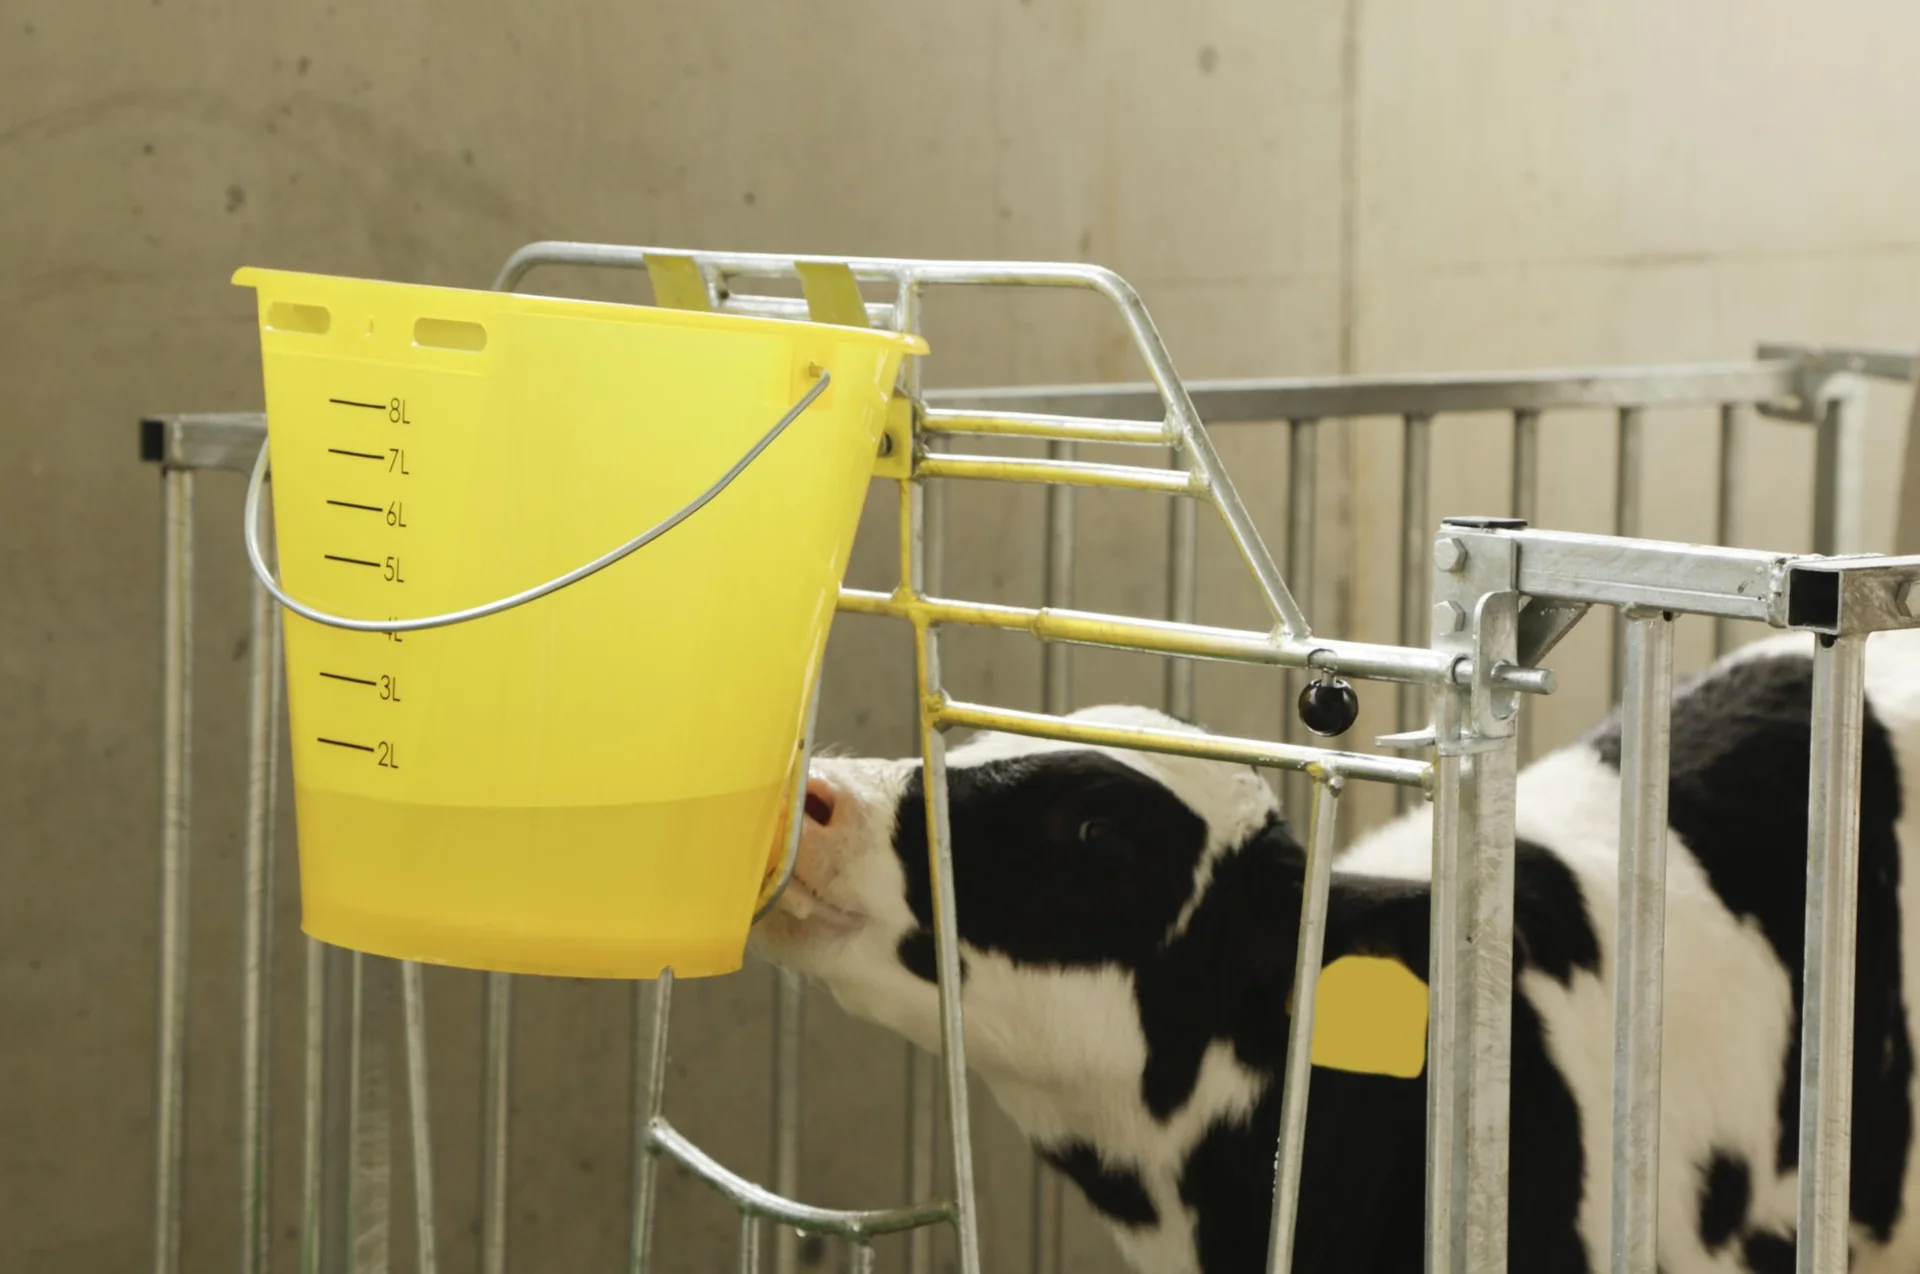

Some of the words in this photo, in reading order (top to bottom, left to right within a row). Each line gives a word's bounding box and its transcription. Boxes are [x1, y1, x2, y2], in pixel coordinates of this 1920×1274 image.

[388, 397, 411, 425] 8L
[388, 448, 410, 475] 7L
[386, 501, 407, 528] 6L
[384, 556, 405, 583] 5L
[379, 674, 401, 702] 3L
[378, 741, 399, 769] 2L
